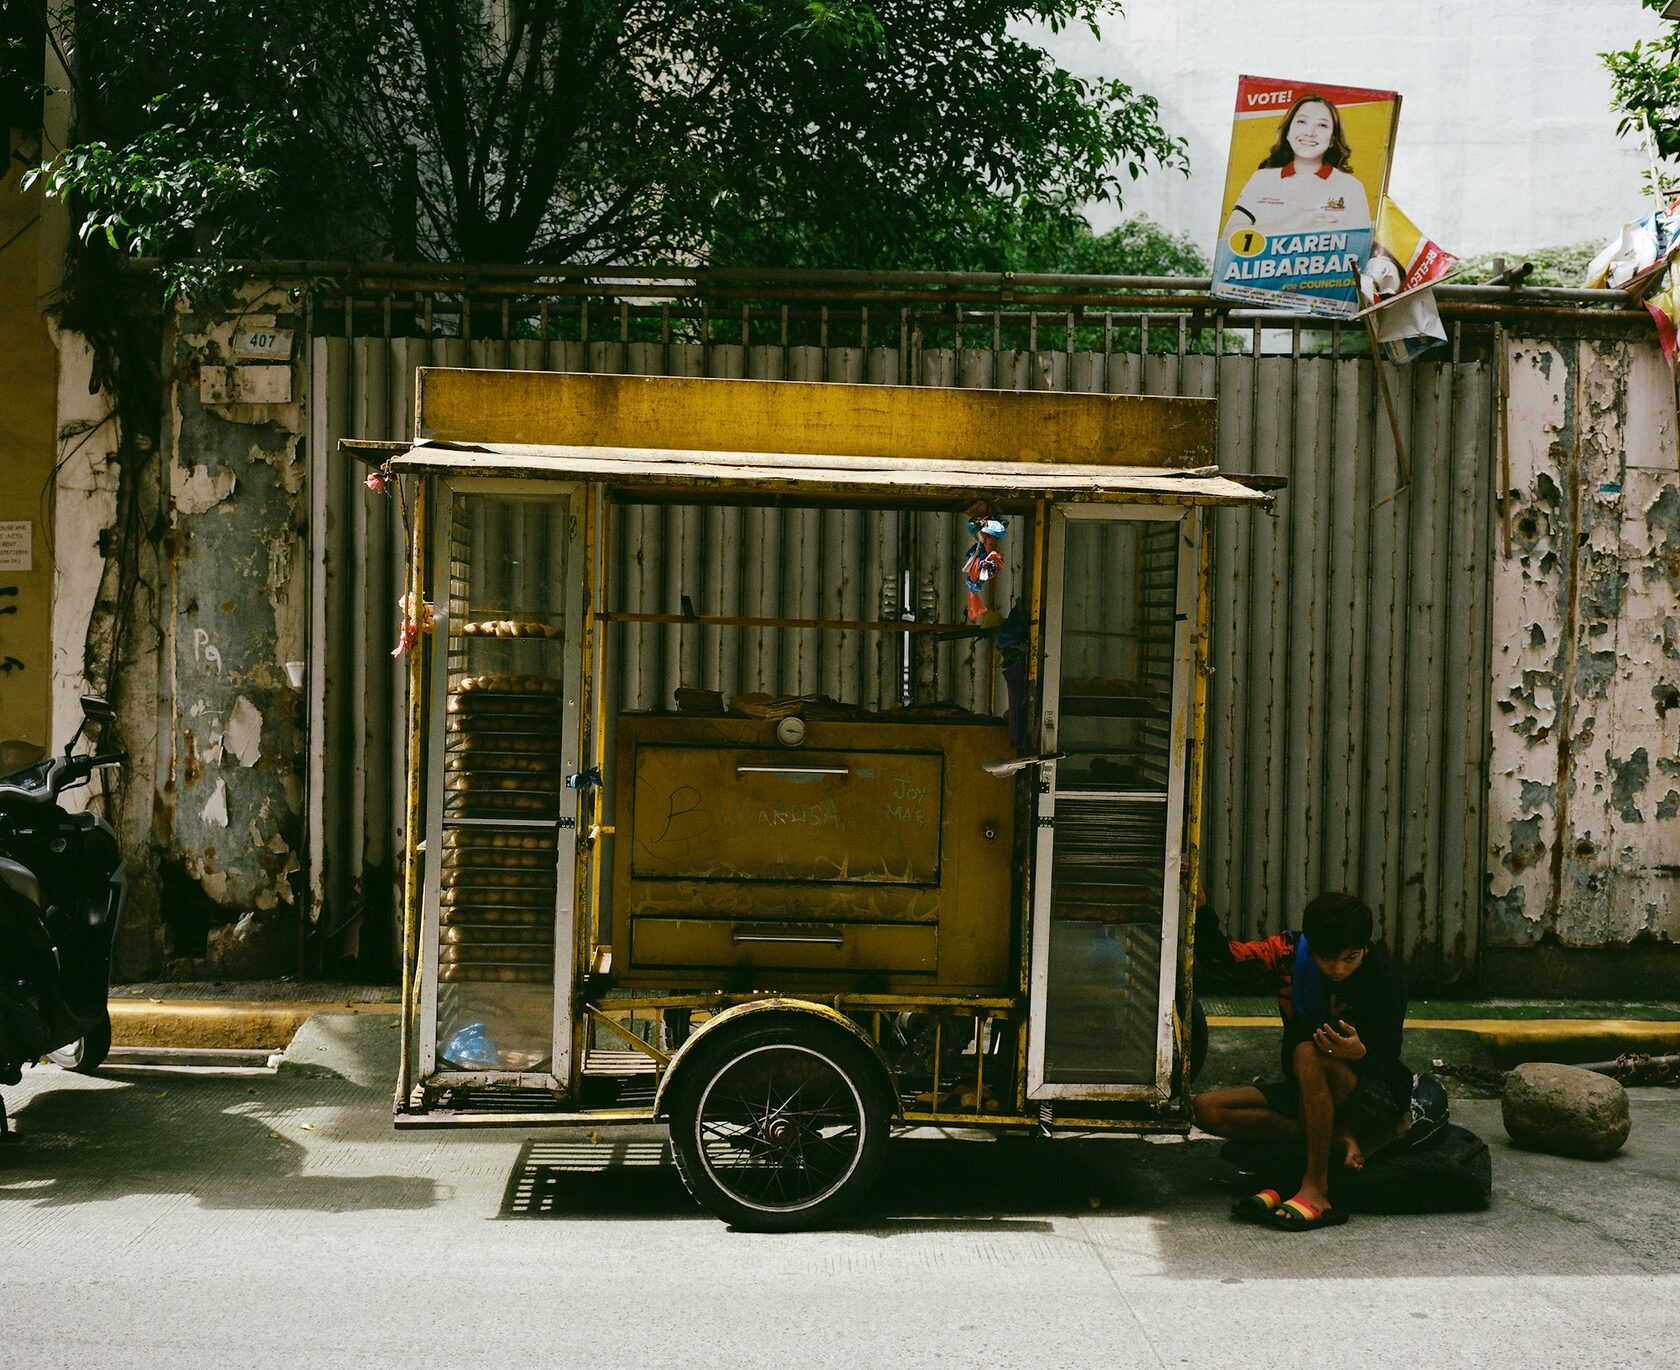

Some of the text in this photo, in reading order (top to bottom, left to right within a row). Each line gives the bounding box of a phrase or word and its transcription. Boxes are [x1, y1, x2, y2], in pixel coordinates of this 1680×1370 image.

[1247, 90, 1293, 106] VOTE!
[1241, 233, 1348, 255] 1 KAREN
[1224, 255, 1360, 280] ALIBARBAR
[1282, 283, 1297, 291] FOR
[249, 333, 277, 348] 407
